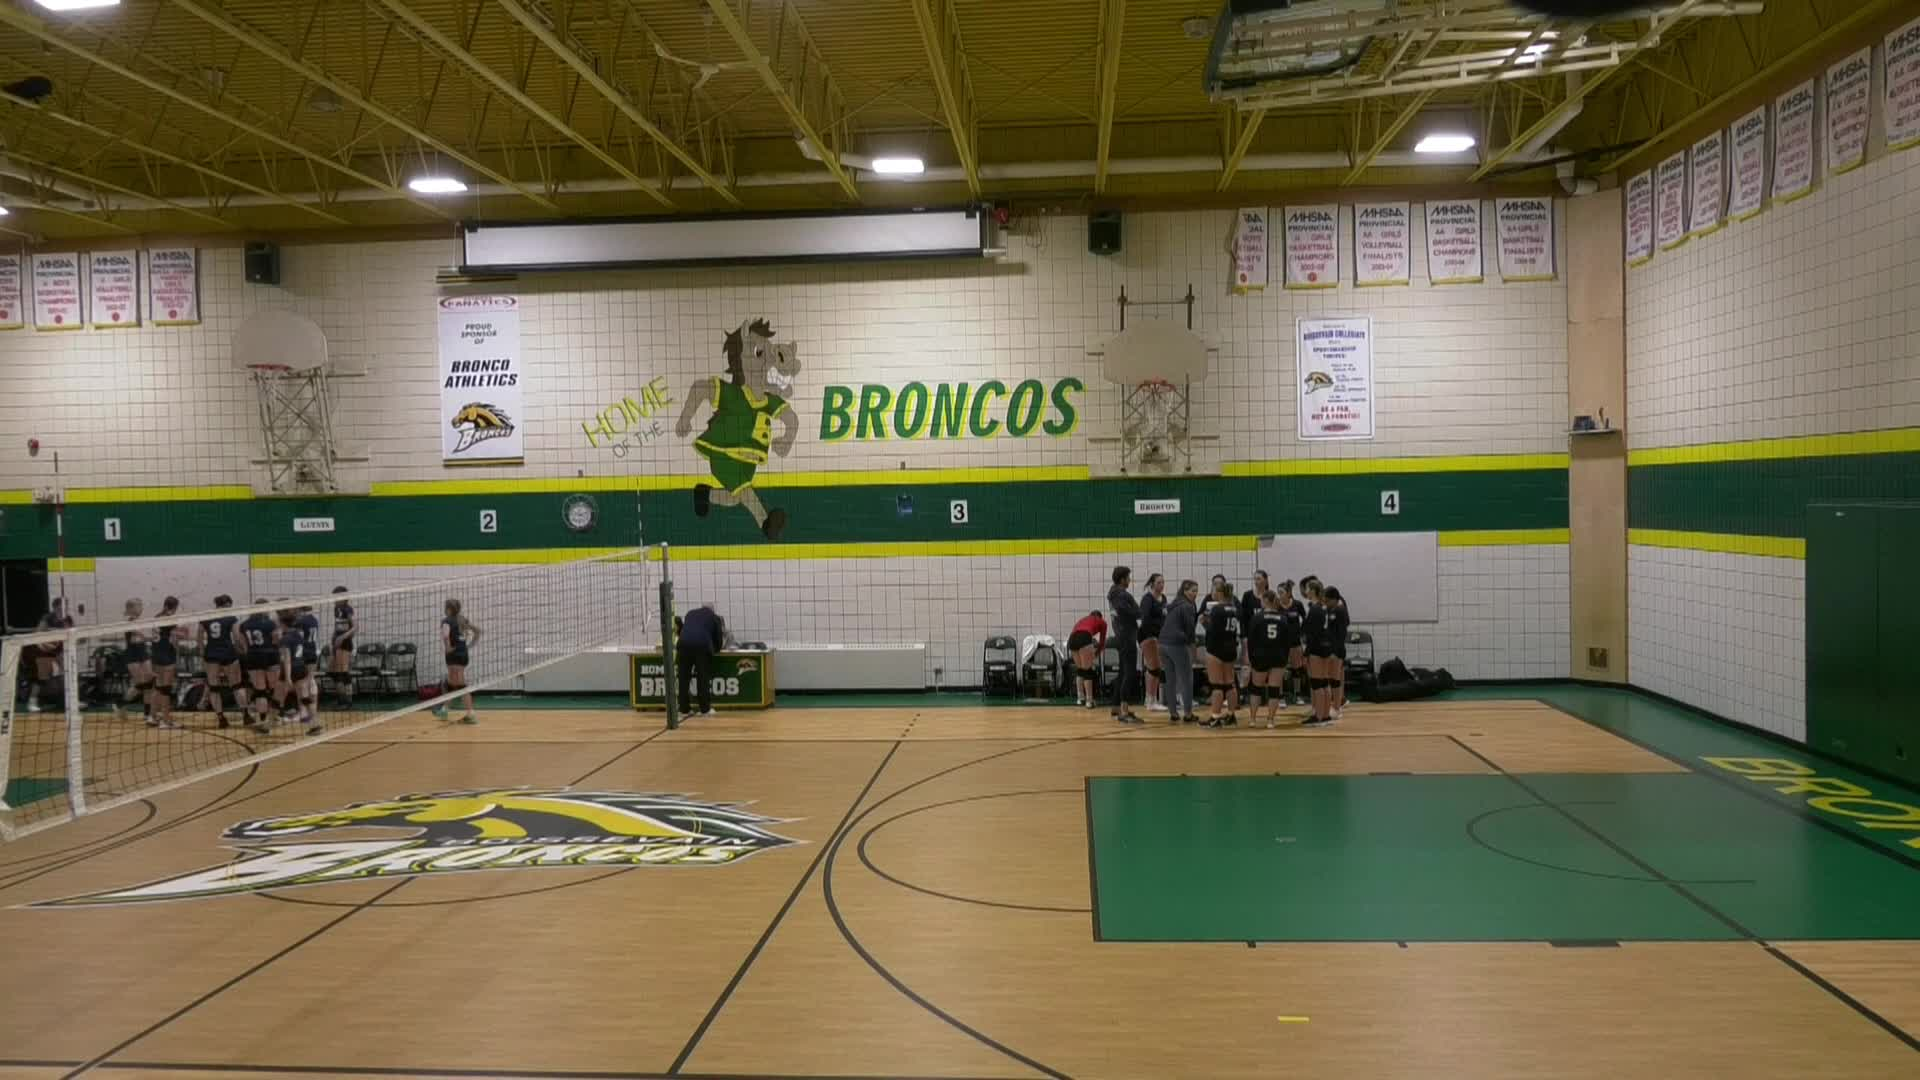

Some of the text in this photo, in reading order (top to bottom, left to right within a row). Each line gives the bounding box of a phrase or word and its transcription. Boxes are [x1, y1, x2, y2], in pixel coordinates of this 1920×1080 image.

[451, 359, 511, 373] BRONCO
[444, 373, 518, 388] ATHLETICS
[582, 376, 673, 448] HOME
[819, 377, 1088, 441] BRONCOS
[612, 420, 665, 458] OF THE
[1384, 493, 1396, 511] 4
[953, 503, 964, 520] 3
[108, 521, 117, 537] 1
[483, 513, 494, 530] 2
[210, 622, 221, 638] 9
[1267, 624, 1277, 639] 5
[641, 665, 666, 675] HOM
